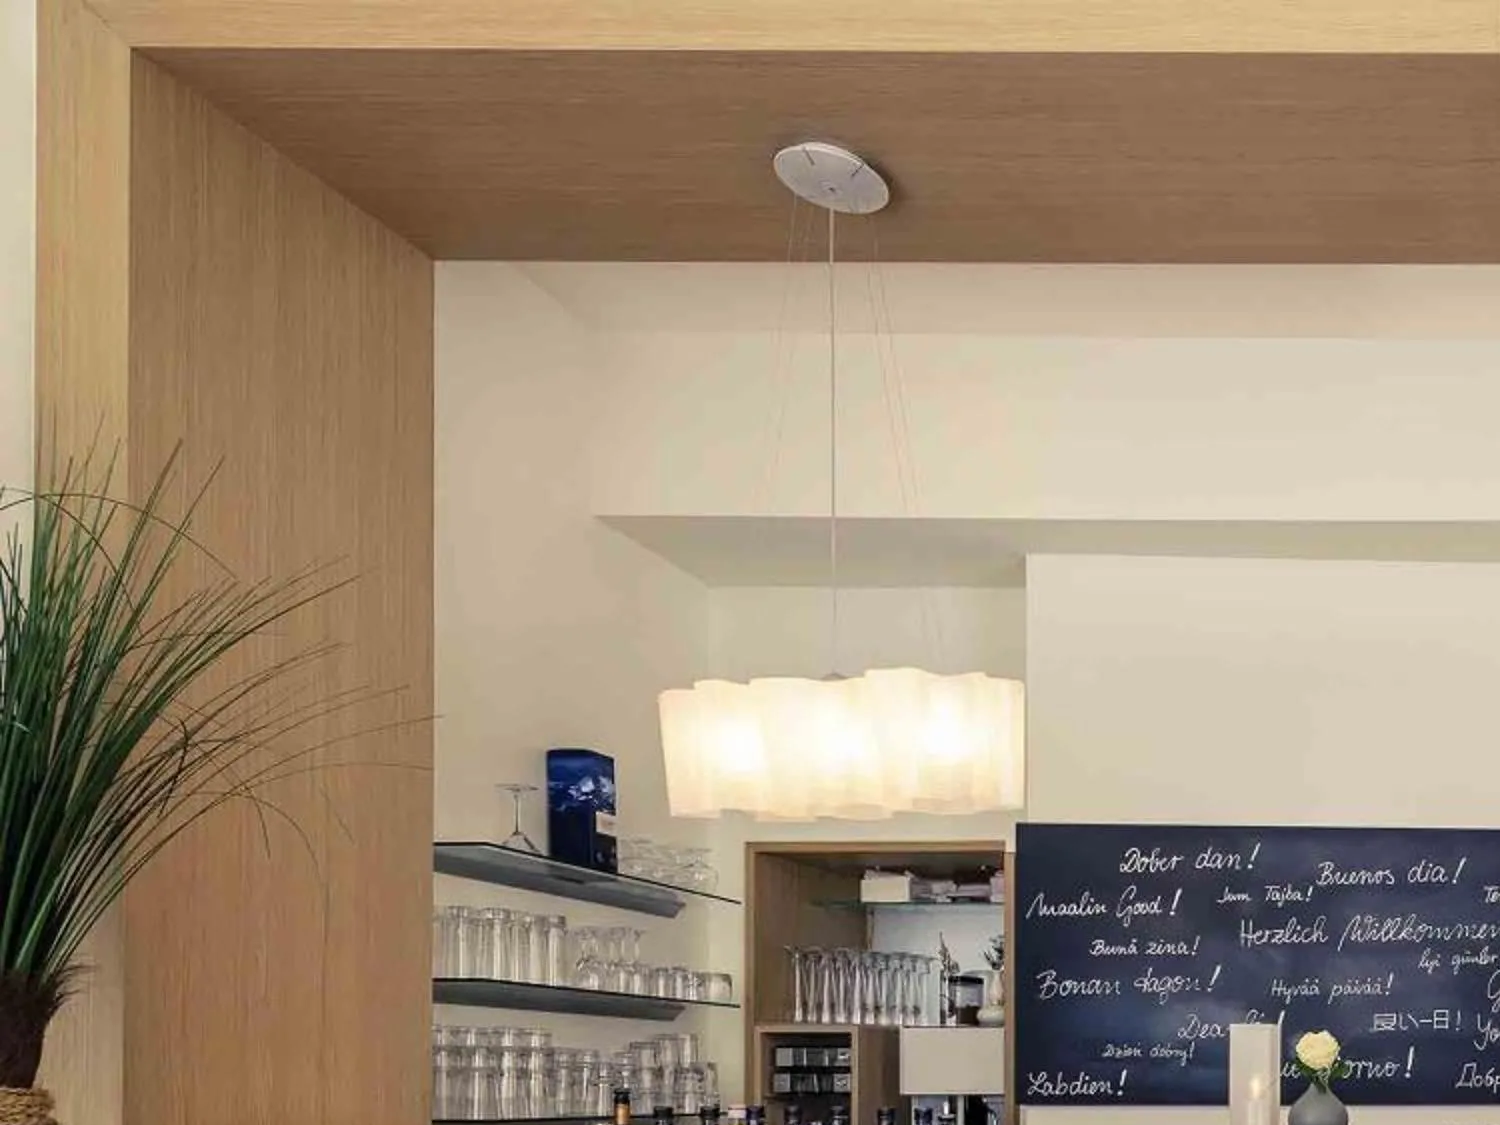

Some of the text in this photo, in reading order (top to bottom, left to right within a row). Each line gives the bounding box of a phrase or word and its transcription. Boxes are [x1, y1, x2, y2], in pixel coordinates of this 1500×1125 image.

[1119, 843, 1261, 873] Dober dan!
[1316, 861, 1395, 885] Buenos
[1240, 916, 1329, 947] Herzlich
[1036, 969, 1121, 1000] Bonan
[1027, 1069, 1128, 1097] Labdien!
